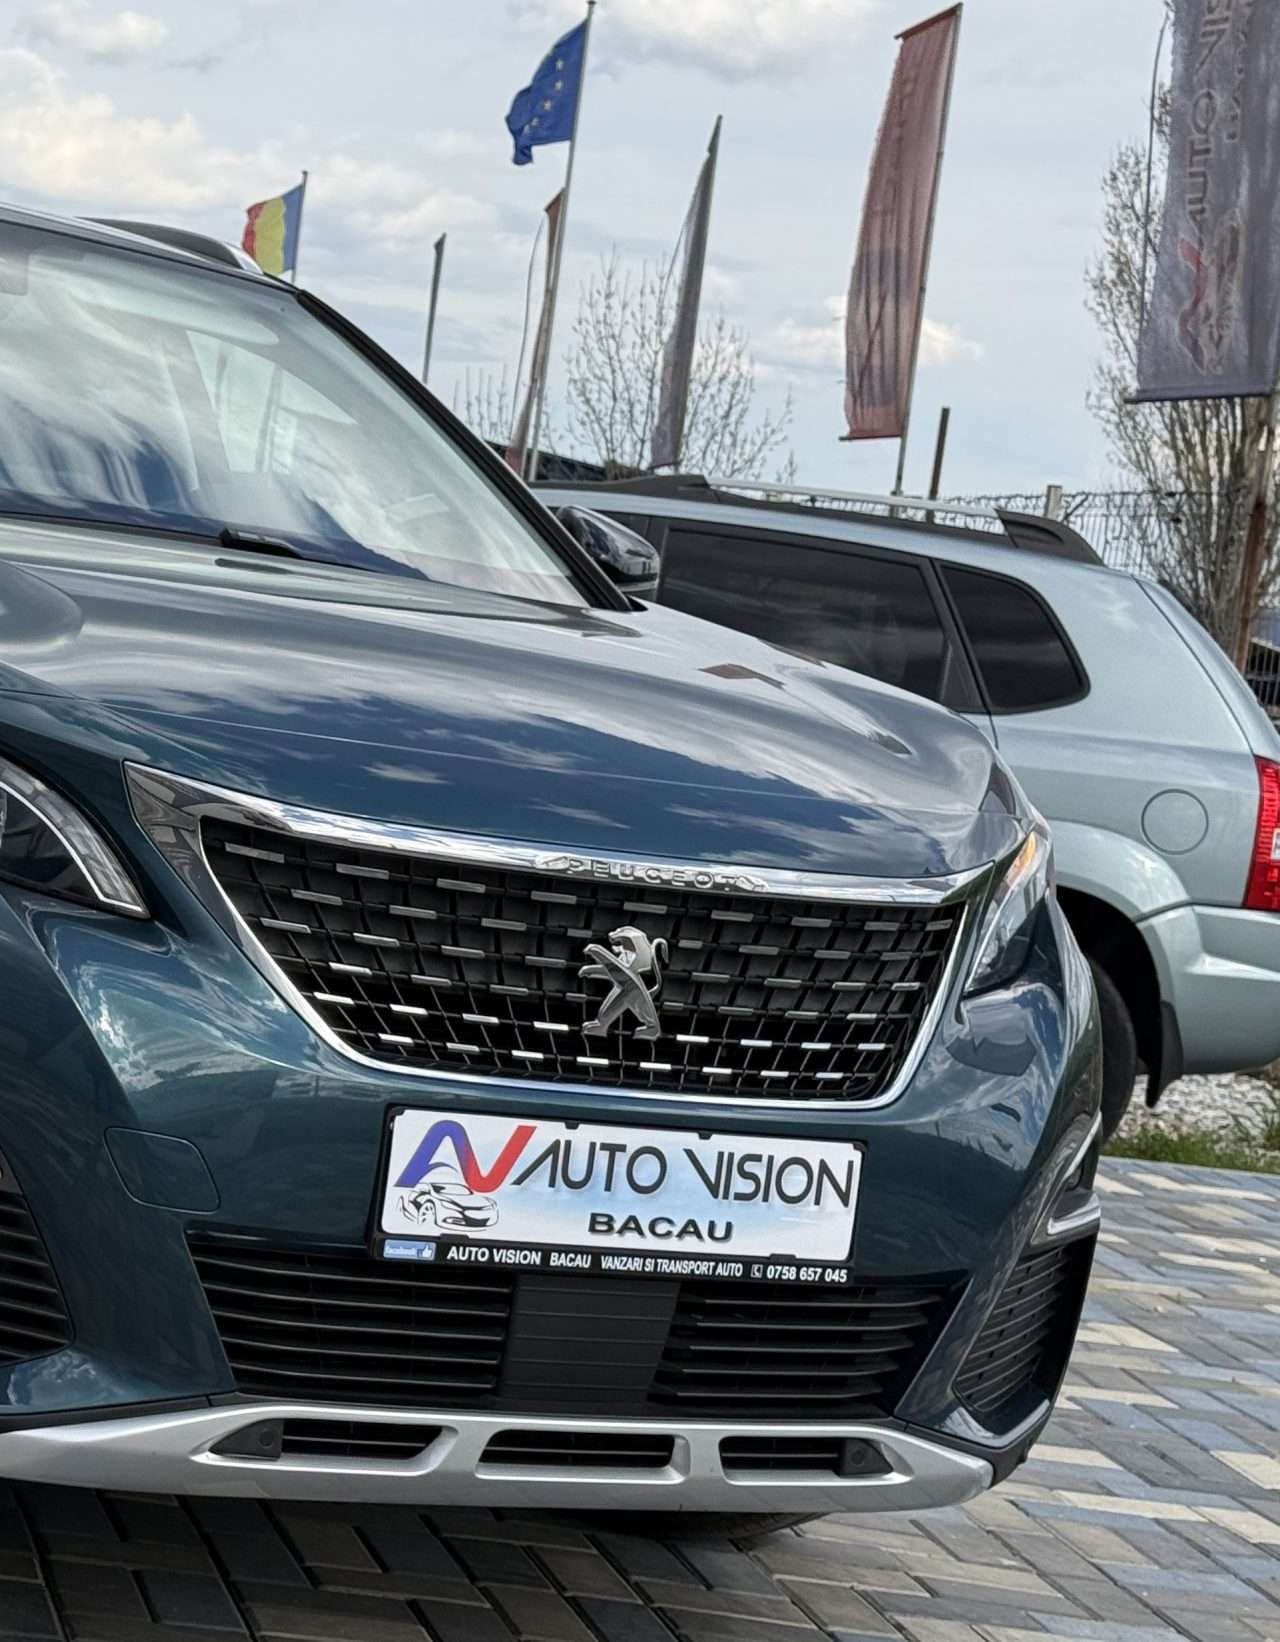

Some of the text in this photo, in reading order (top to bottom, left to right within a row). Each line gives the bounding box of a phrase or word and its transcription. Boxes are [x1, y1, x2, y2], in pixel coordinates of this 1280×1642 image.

[568, 857, 738, 890] PEUGEOT
[509, 1138, 668, 1195] AUTO
[683, 1147, 854, 1208] VISION
[587, 1212, 734, 1242] BACAU
[447, 1246, 847, 1283] AUTO VISION BACAU VANZARI SI TRANSPORT AUTO 0758 657 045
